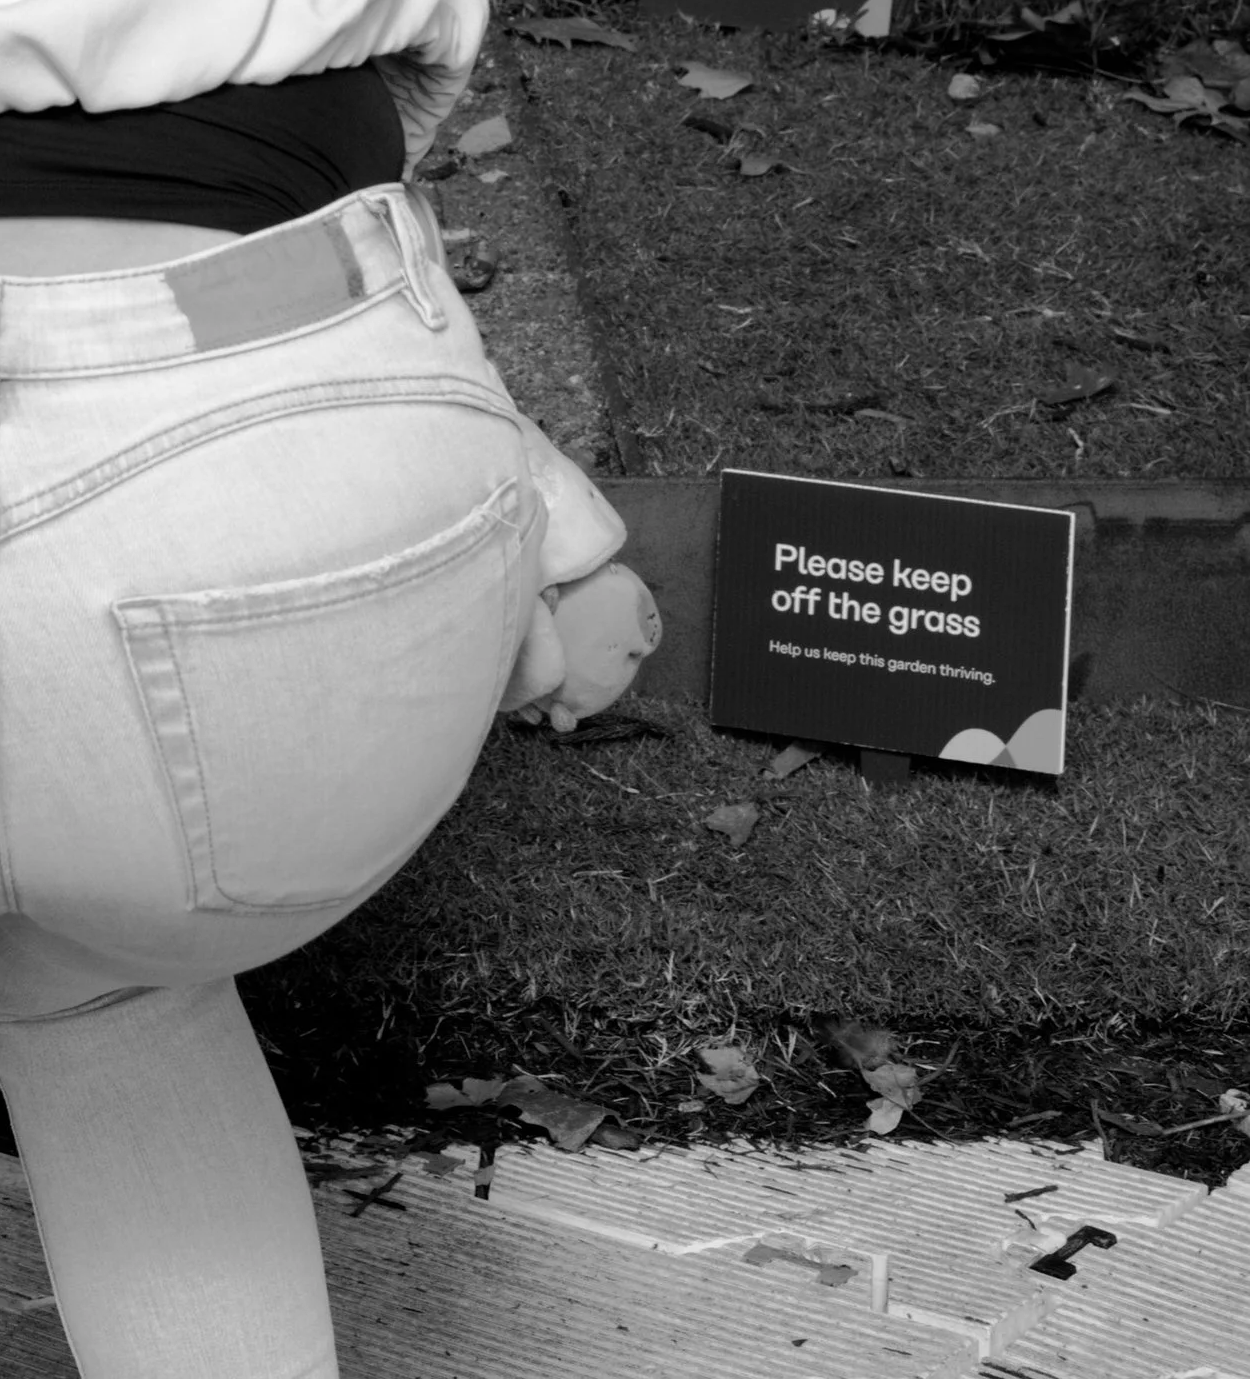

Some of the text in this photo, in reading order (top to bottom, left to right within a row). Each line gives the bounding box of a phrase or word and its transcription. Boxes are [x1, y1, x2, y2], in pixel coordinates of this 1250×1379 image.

[774, 543, 972, 602] Please keep
[771, 586, 981, 637] off the grass
[768, 639, 996, 686] Help us keep this garden thriving.
